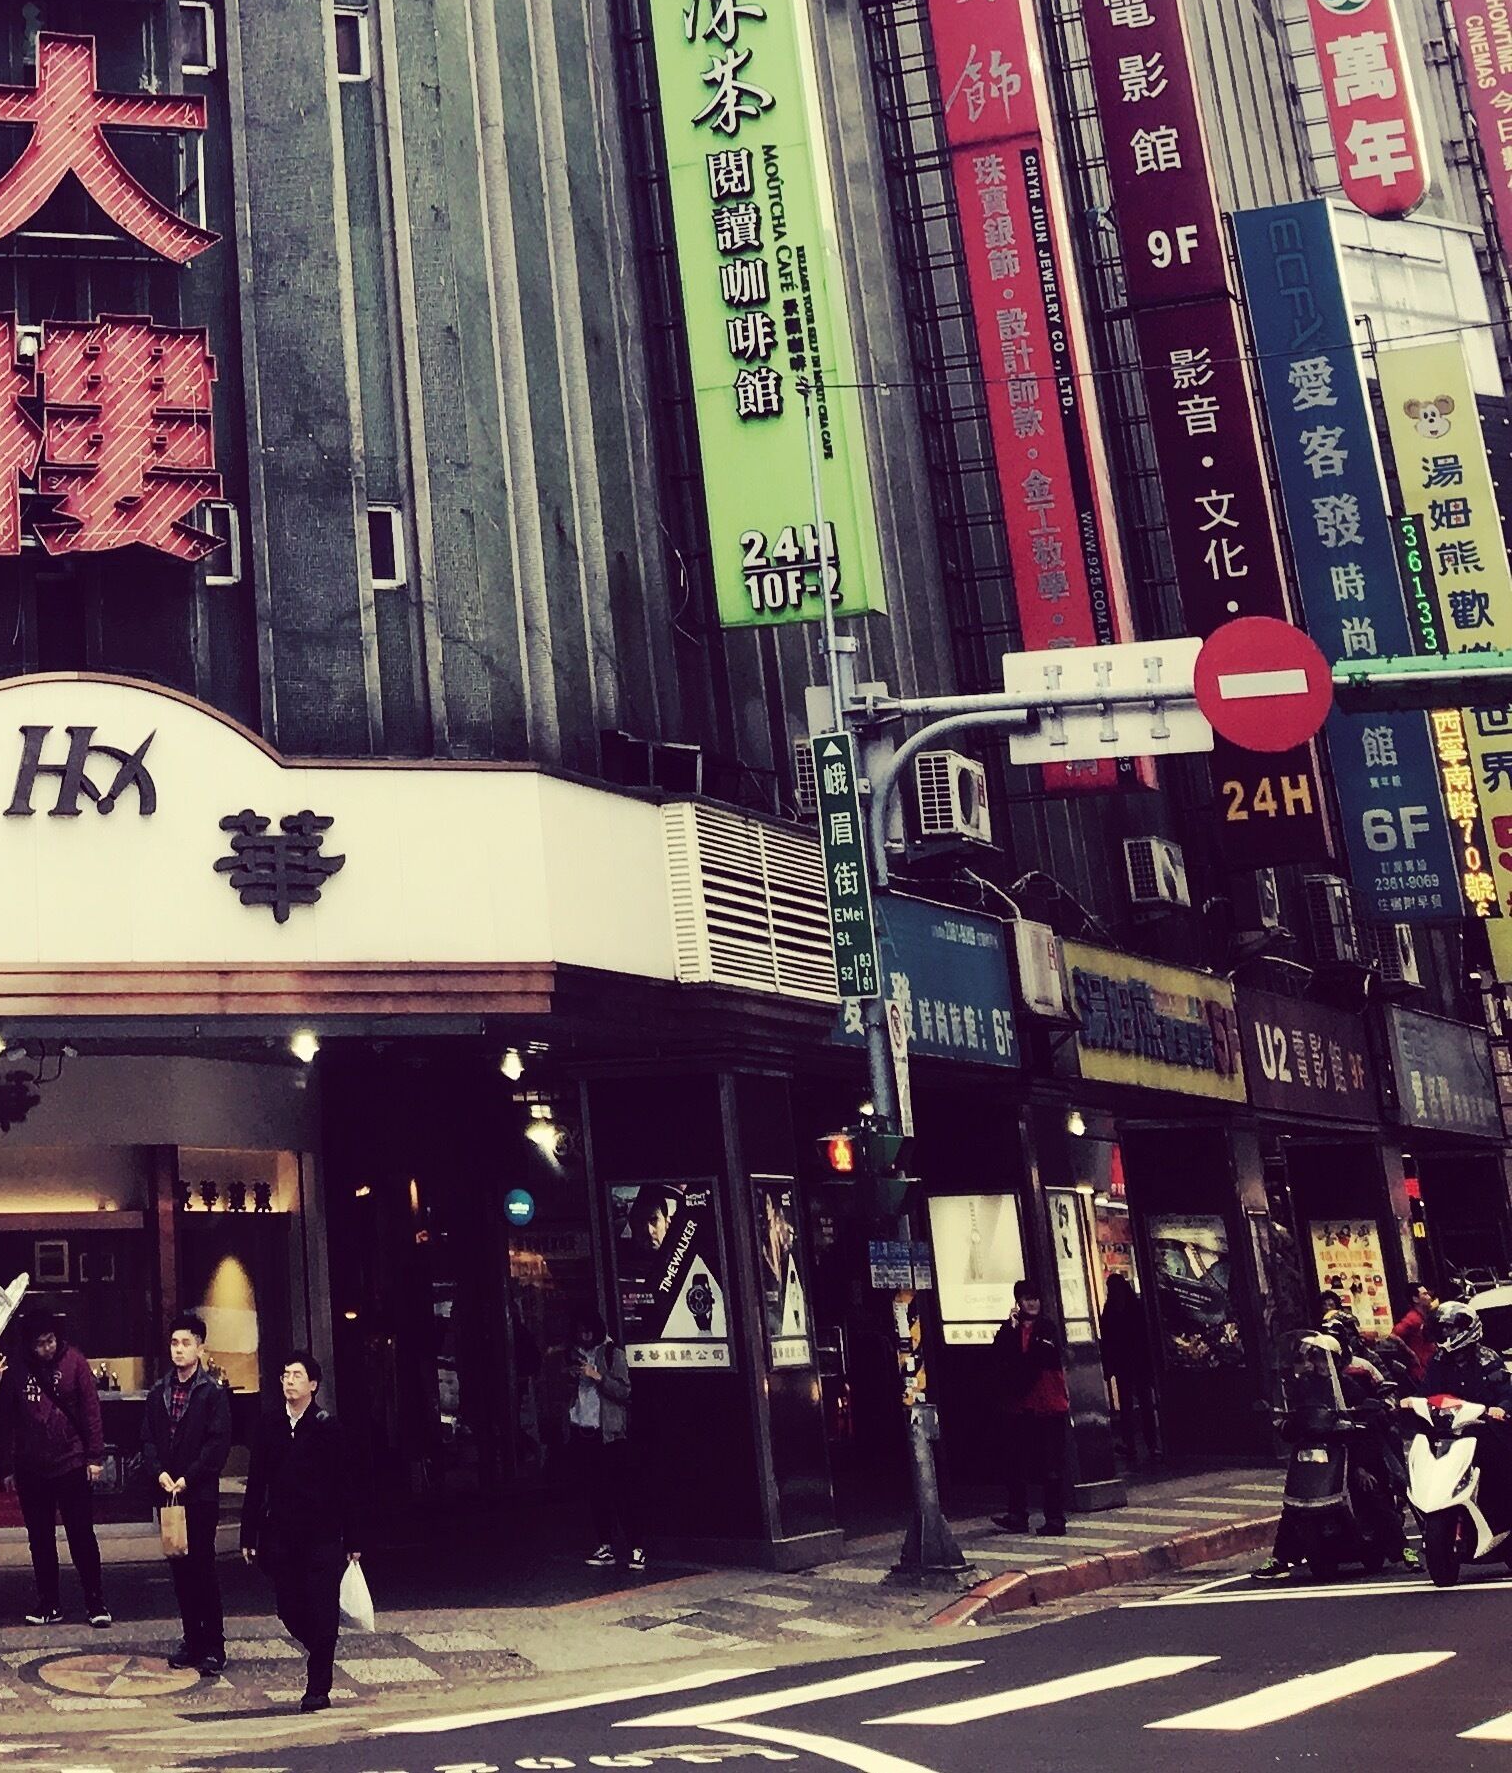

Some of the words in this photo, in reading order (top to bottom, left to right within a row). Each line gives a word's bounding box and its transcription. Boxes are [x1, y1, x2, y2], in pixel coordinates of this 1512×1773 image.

[1464, 14, 1496, 90] CINEMAS
[1326, 30, 1414, 187] 萬年
[1024, 154, 1042, 205] CHYH
[1032, 205, 1048, 244] JIUN
[1148, 225, 1199, 269] 9F
[705, 147, 783, 421] 閱讀咖啡館
[1037, 245, 1062, 326] JEWELRY
[802, 295, 815, 325] YOUR
[1058, 375, 1073, 415] LTD.
[740, 525, 839, 570] 24H
[745, 568, 843, 614] 10F-2
[1222, 773, 1314, 822] 24H
[824, 761, 859, 897] 峨眉街
[1362, 805, 1430, 852] 6F
[834, 907, 865, 923] EMei
[841, 966, 854, 981] 52
[992, 1007, 1013, 1057] 6F
[1254, 1021, 1293, 1084] U2
[658, 1218, 698, 1293] TIMEWALKER
